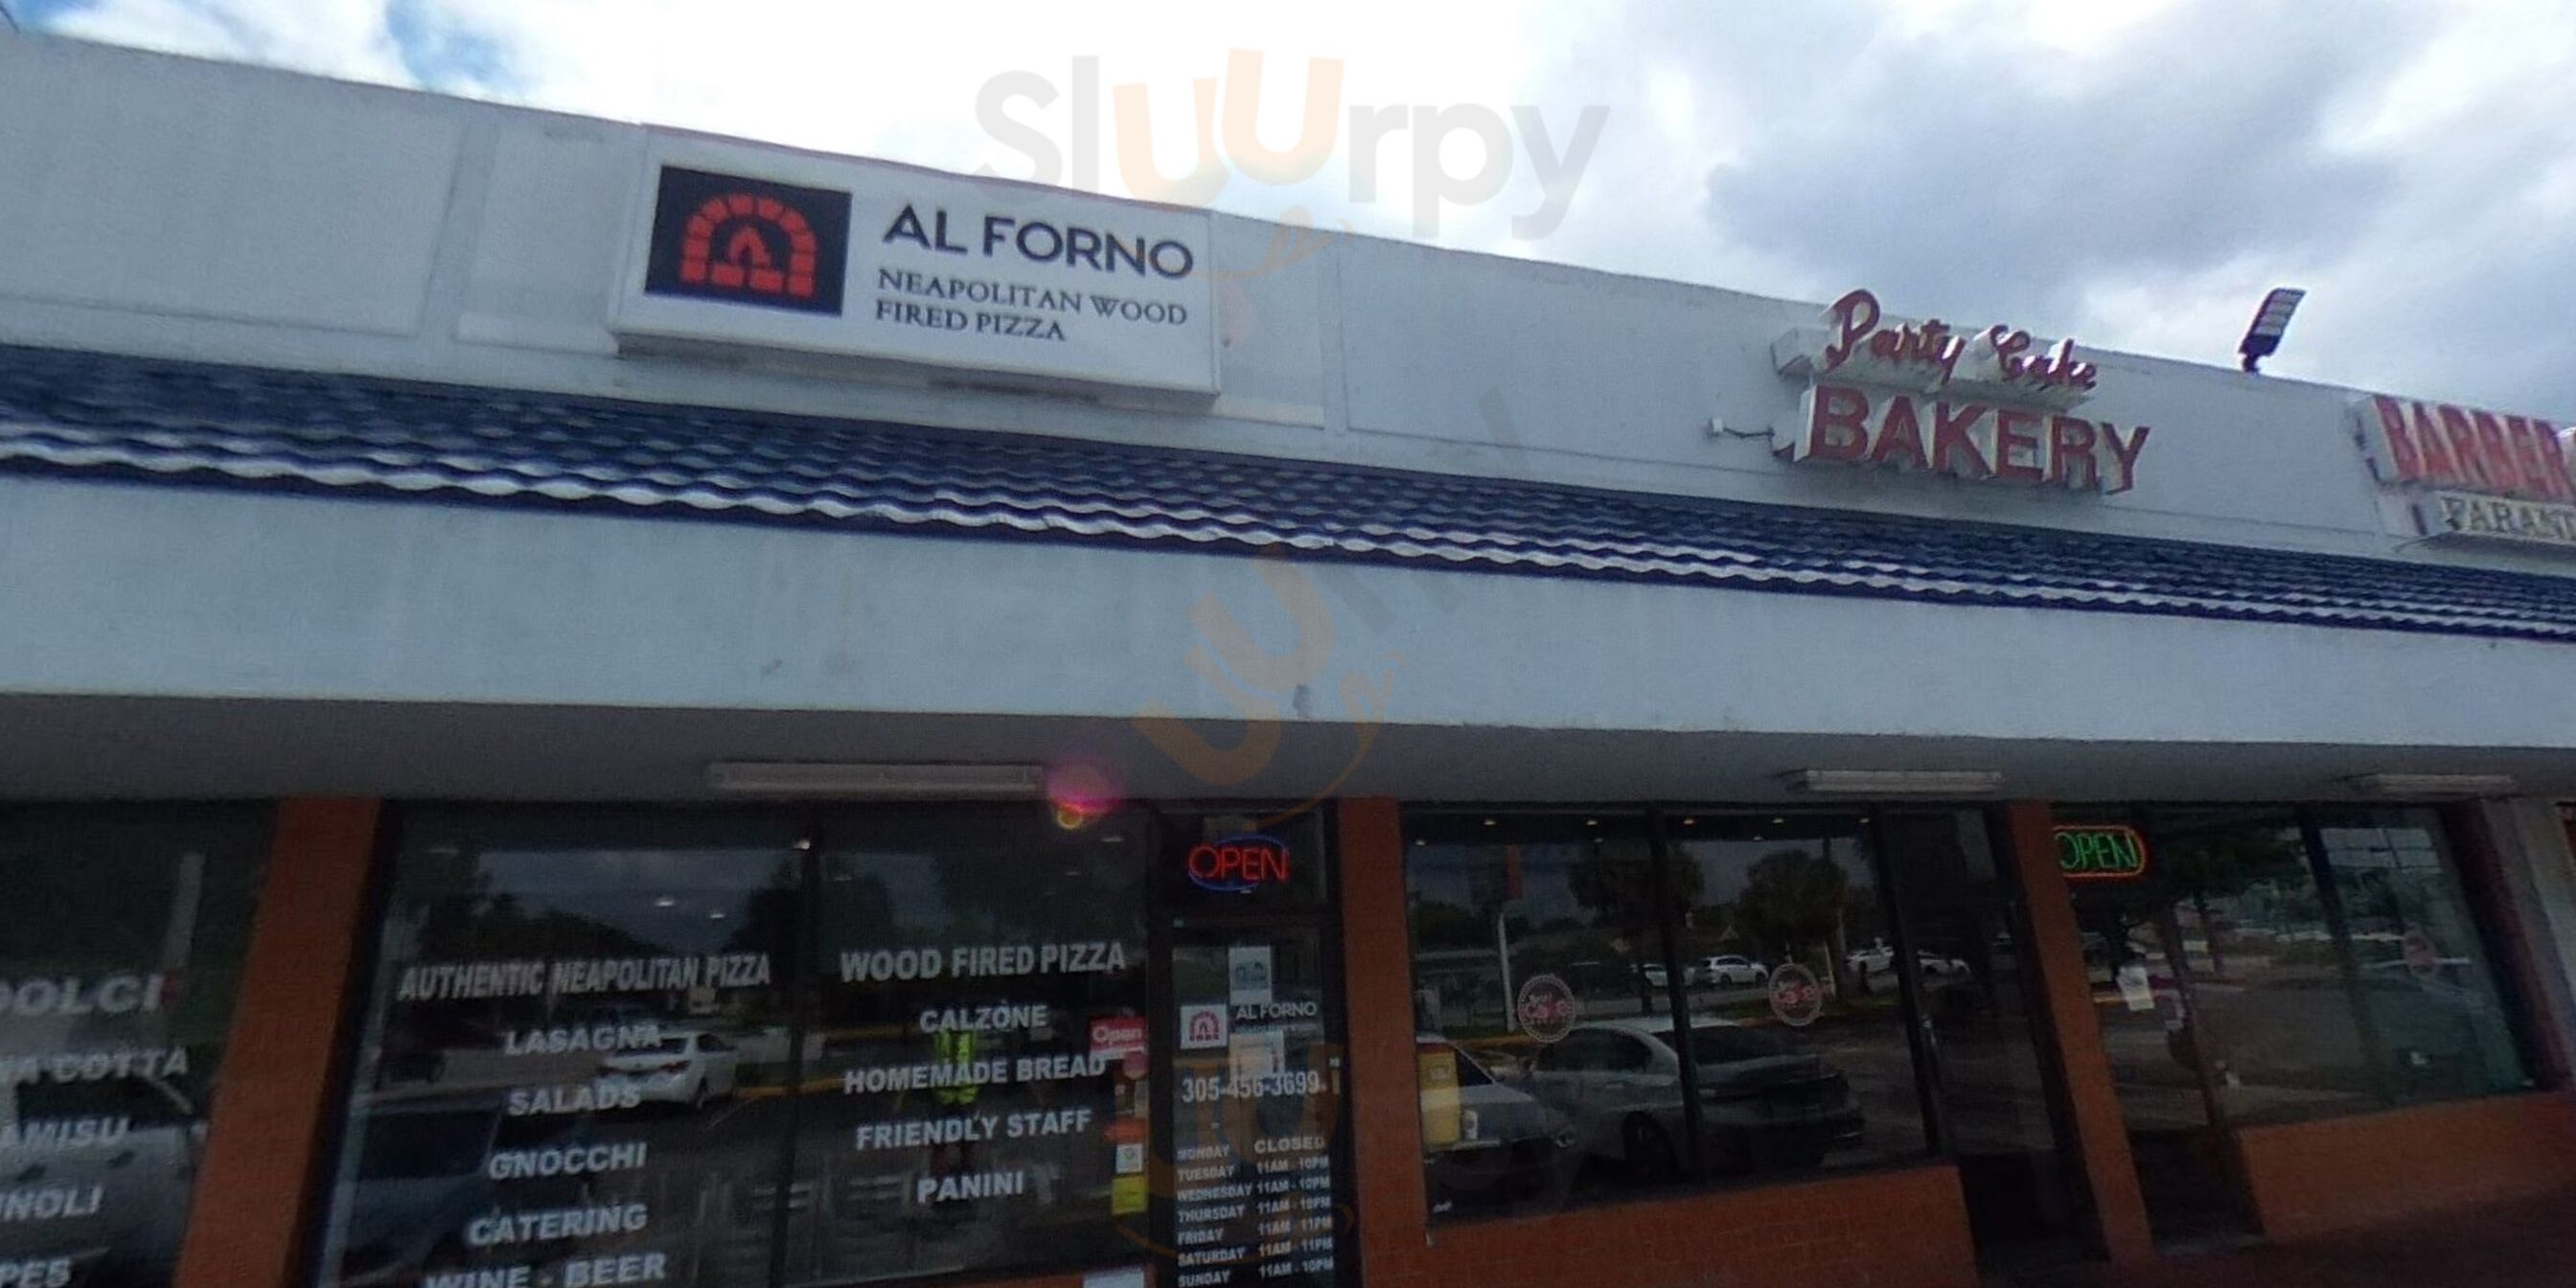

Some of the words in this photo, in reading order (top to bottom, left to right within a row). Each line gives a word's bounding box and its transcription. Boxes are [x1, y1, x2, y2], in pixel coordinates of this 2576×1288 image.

[883, 205, 967, 255] AL
[984, 216, 1193, 280] FORNO
[876, 267, 1083, 313] NEAPOLITAN
[1092, 295, 1187, 327] WOOD
[874, 299, 968, 332] FIRED
[975, 310, 1067, 342] PIZZA
[1825, 288, 1965, 383] Party
[1808, 383, 2150, 494] BAKERY
[2375, 395, 2575, 503] BARBER
[1188, 843, 1291, 882] OPEN
[2055, 832, 2138, 869] OPEN
[397, 961, 545, 1001] AUTHENTIC
[552, 956, 700, 995] NEAPOLITAN
[705, 954, 770, 988] PIZZA
[840, 949, 942, 983] WOOD
[951, 946, 1035, 978] FIRED
[1040, 942, 1127, 974] PIZZA
[919, 1004, 1049, 1032] CALZONE
[1236, 1005, 1257, 1020] AL
[1260, 1001, 1318, 1019] FORNO
[504, 1024, 661, 1056] LASAGNA
[843, 1062, 1009, 1094] HOMEMADE
[1016, 1055, 1106, 1084] BREAD
[1182, 1070, 1320, 1102] 305-456-3699
[508, 1079, 642, 1116] SALADS
[857, 1116, 997, 1150] FRIENDLY
[1006, 1110, 1092, 1139] STAFF
[489, 1142, 648, 1180] GNOCCHI
[1177, 1144, 1230, 1161] MONDAY
[1254, 1137, 1325, 1154] CLOSED
[918, 1171, 1024, 1205] PANINI
[1177, 1165, 1234, 1182] TUESDAY
[1256, 1160, 1289, 1174] 11AM
[1177, 1183, 1253, 1202] WEDNESDAY
[1256, 1180, 1289, 1194] 11AM
[1300, 1176, 1330, 1190] 10PM
[467, 1203, 649, 1247] CATERING
[1177, 1205, 1245, 1224] THURSDAY
[1256, 1200, 1290, 1214] 11AM
[1300, 1197, 1331, 1210] 10PM
[1177, 1228, 1224, 1245] FRIDAY
[1257, 1221, 1291, 1236] 11AM
[425, 1264, 532, 1288] WINE
[564, 1253, 667, 1288] BEER
[1178, 1247, 1246, 1267] SATURDAY
[1259, 1242, 1292, 1257] 11AM
[1178, 1271, 1230, 1288] SUNDAY
[1260, 1263, 1292, 1278] 11AM
[1302, 1257, 1334, 1273] 10PM
